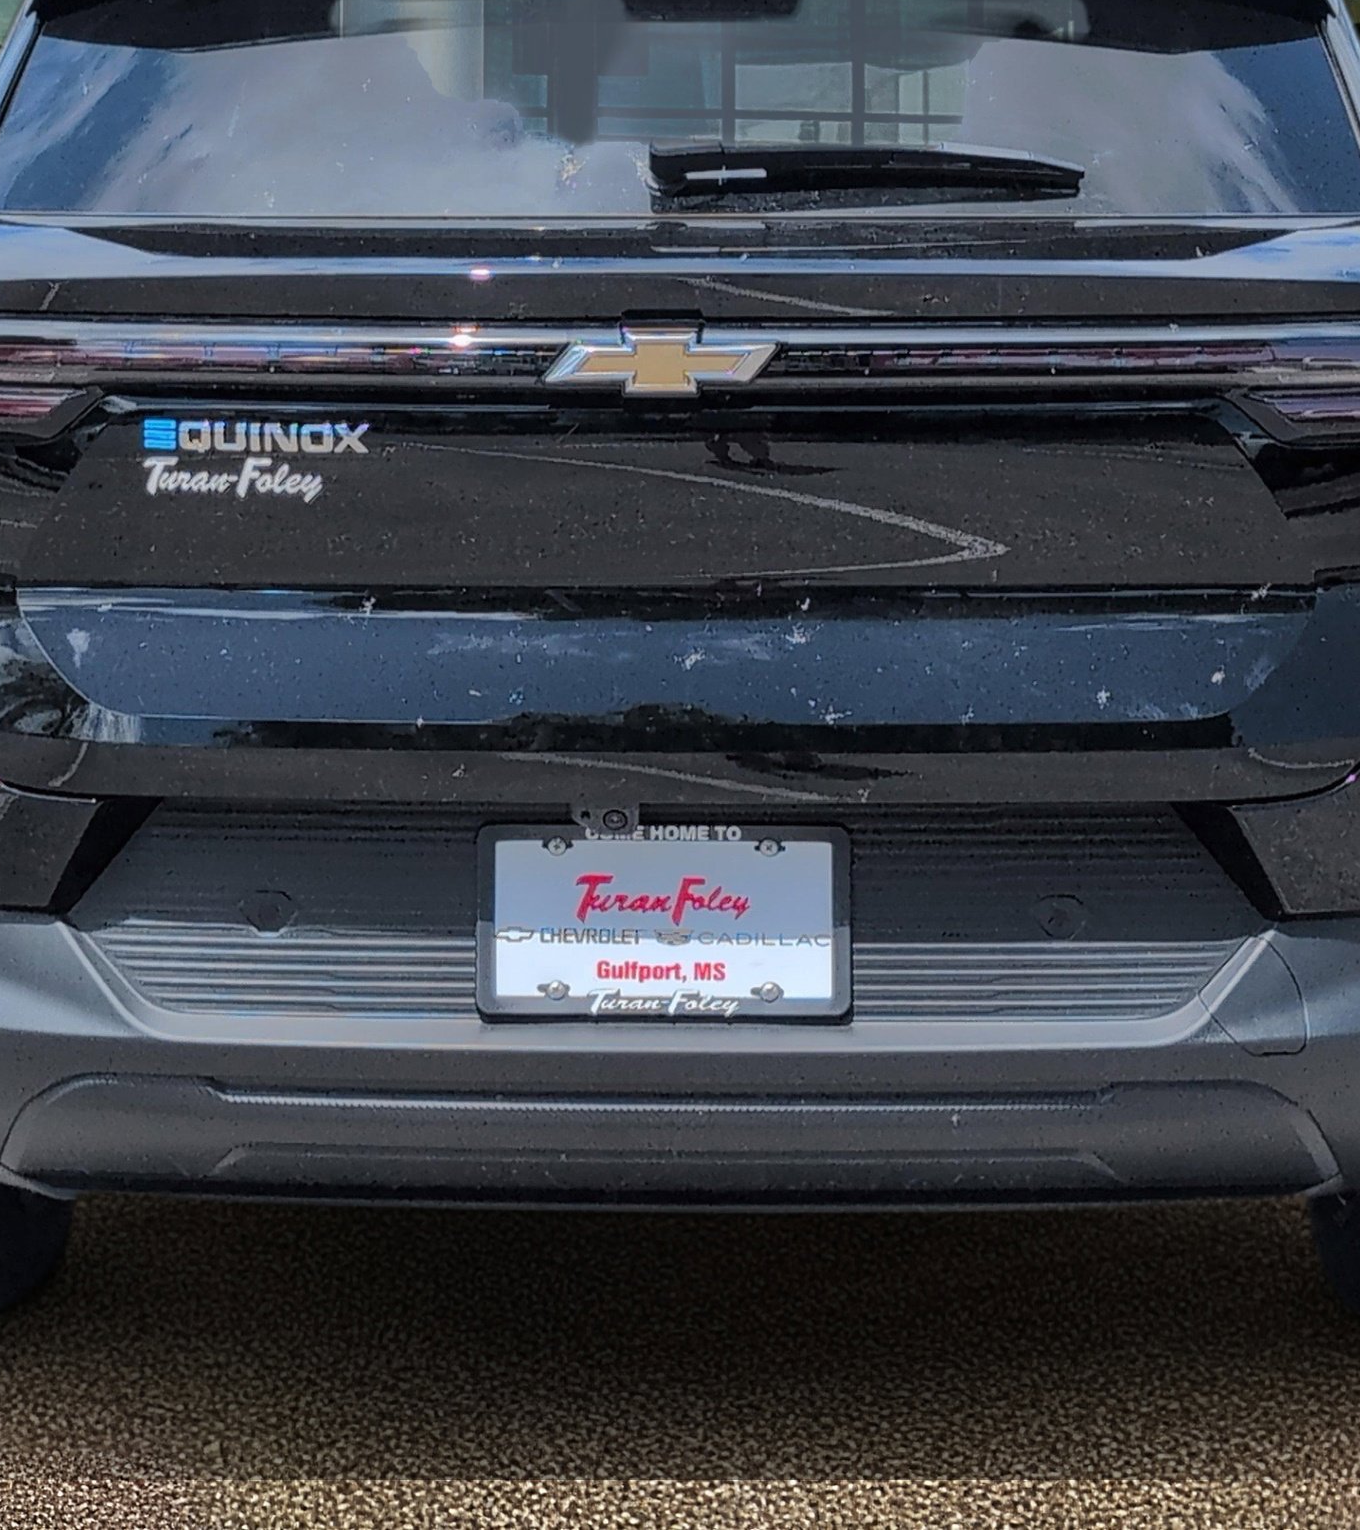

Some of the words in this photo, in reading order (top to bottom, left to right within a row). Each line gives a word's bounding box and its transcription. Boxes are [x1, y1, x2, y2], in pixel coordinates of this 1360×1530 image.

[143, 418, 370, 454] EQUINOX
[649, 824, 710, 841] HOME
[714, 825, 742, 841] TO
[575, 874, 672, 924] Turan
[671, 877, 751, 926] Foley
[539, 927, 645, 945] CHEVROLET
[698, 931, 832, 947] CADILLAC
[596, 960, 688, 983] Gulfport,
[693, 962, 726, 981] MS
